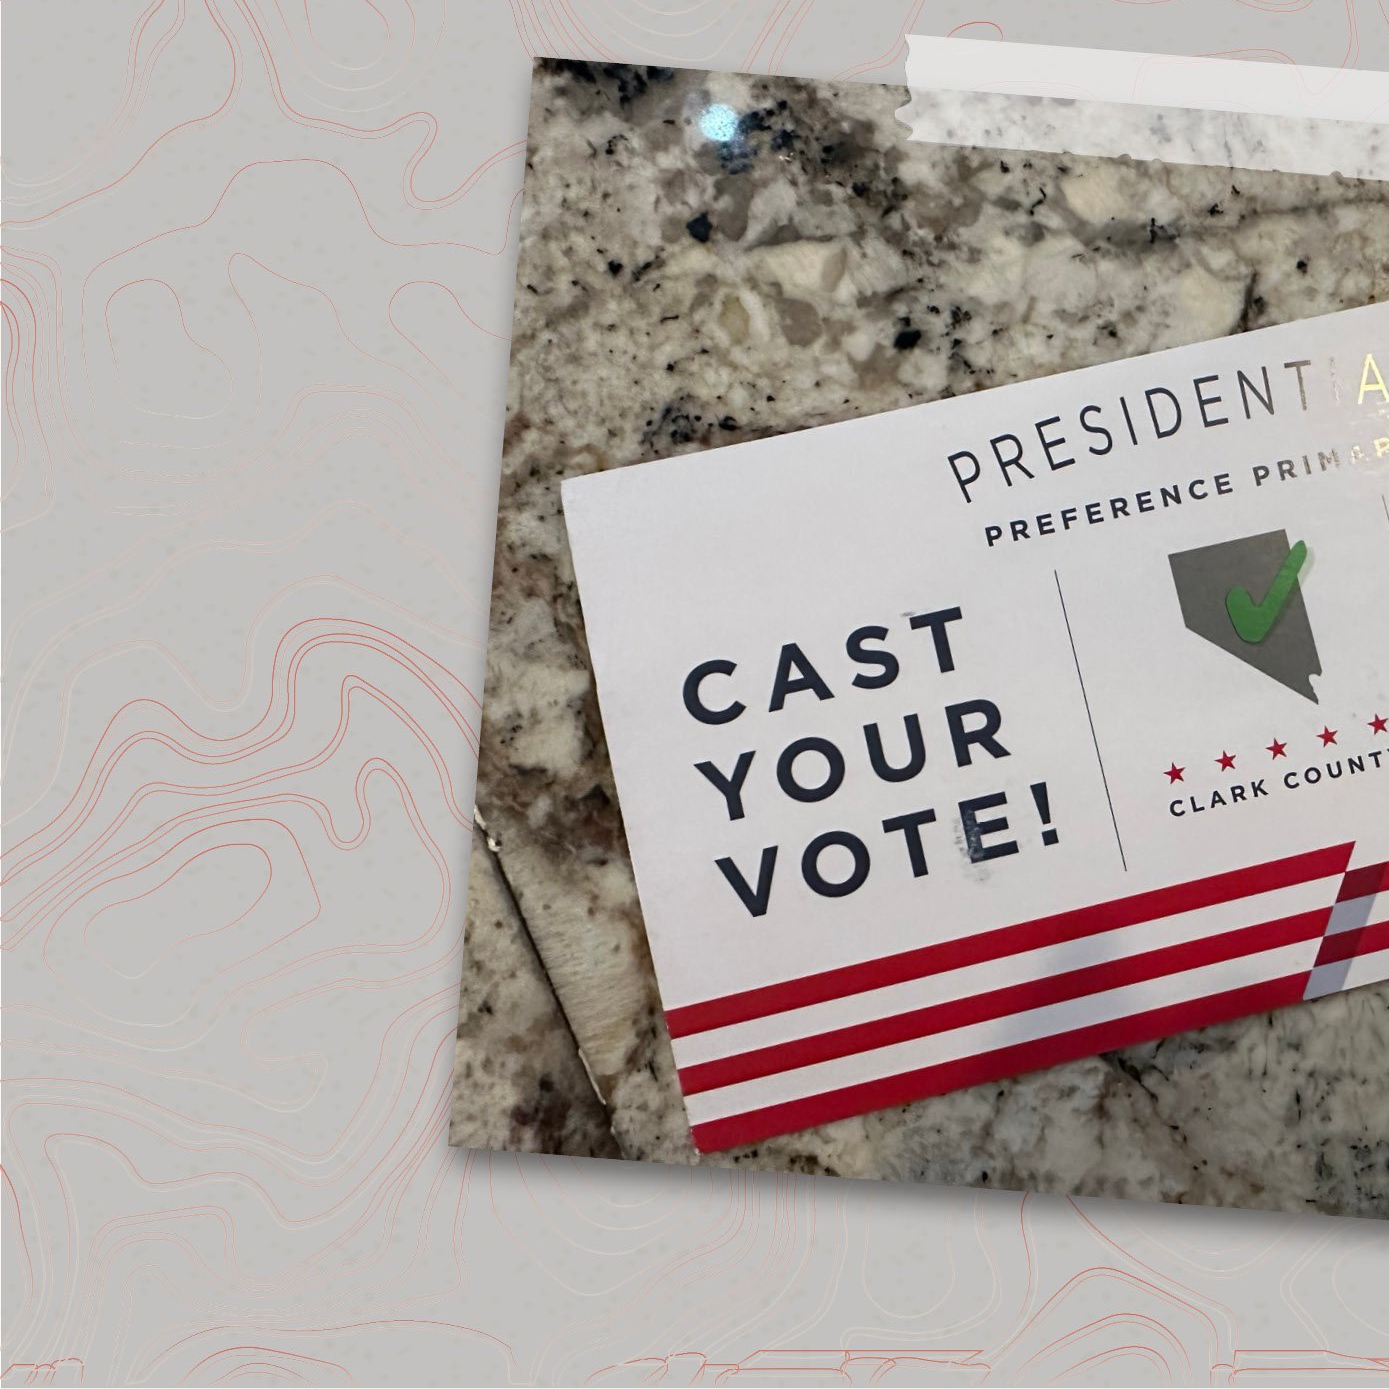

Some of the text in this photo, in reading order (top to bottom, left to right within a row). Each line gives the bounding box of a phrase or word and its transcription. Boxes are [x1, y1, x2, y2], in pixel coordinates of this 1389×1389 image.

[985, 473, 1234, 547] PREFERENCE
[682, 606, 963, 725] CAST
[693, 698, 1011, 821] YOUR
[1169, 779, 1269, 817] CLARK
[714, 781, 1060, 918] VOTE!
